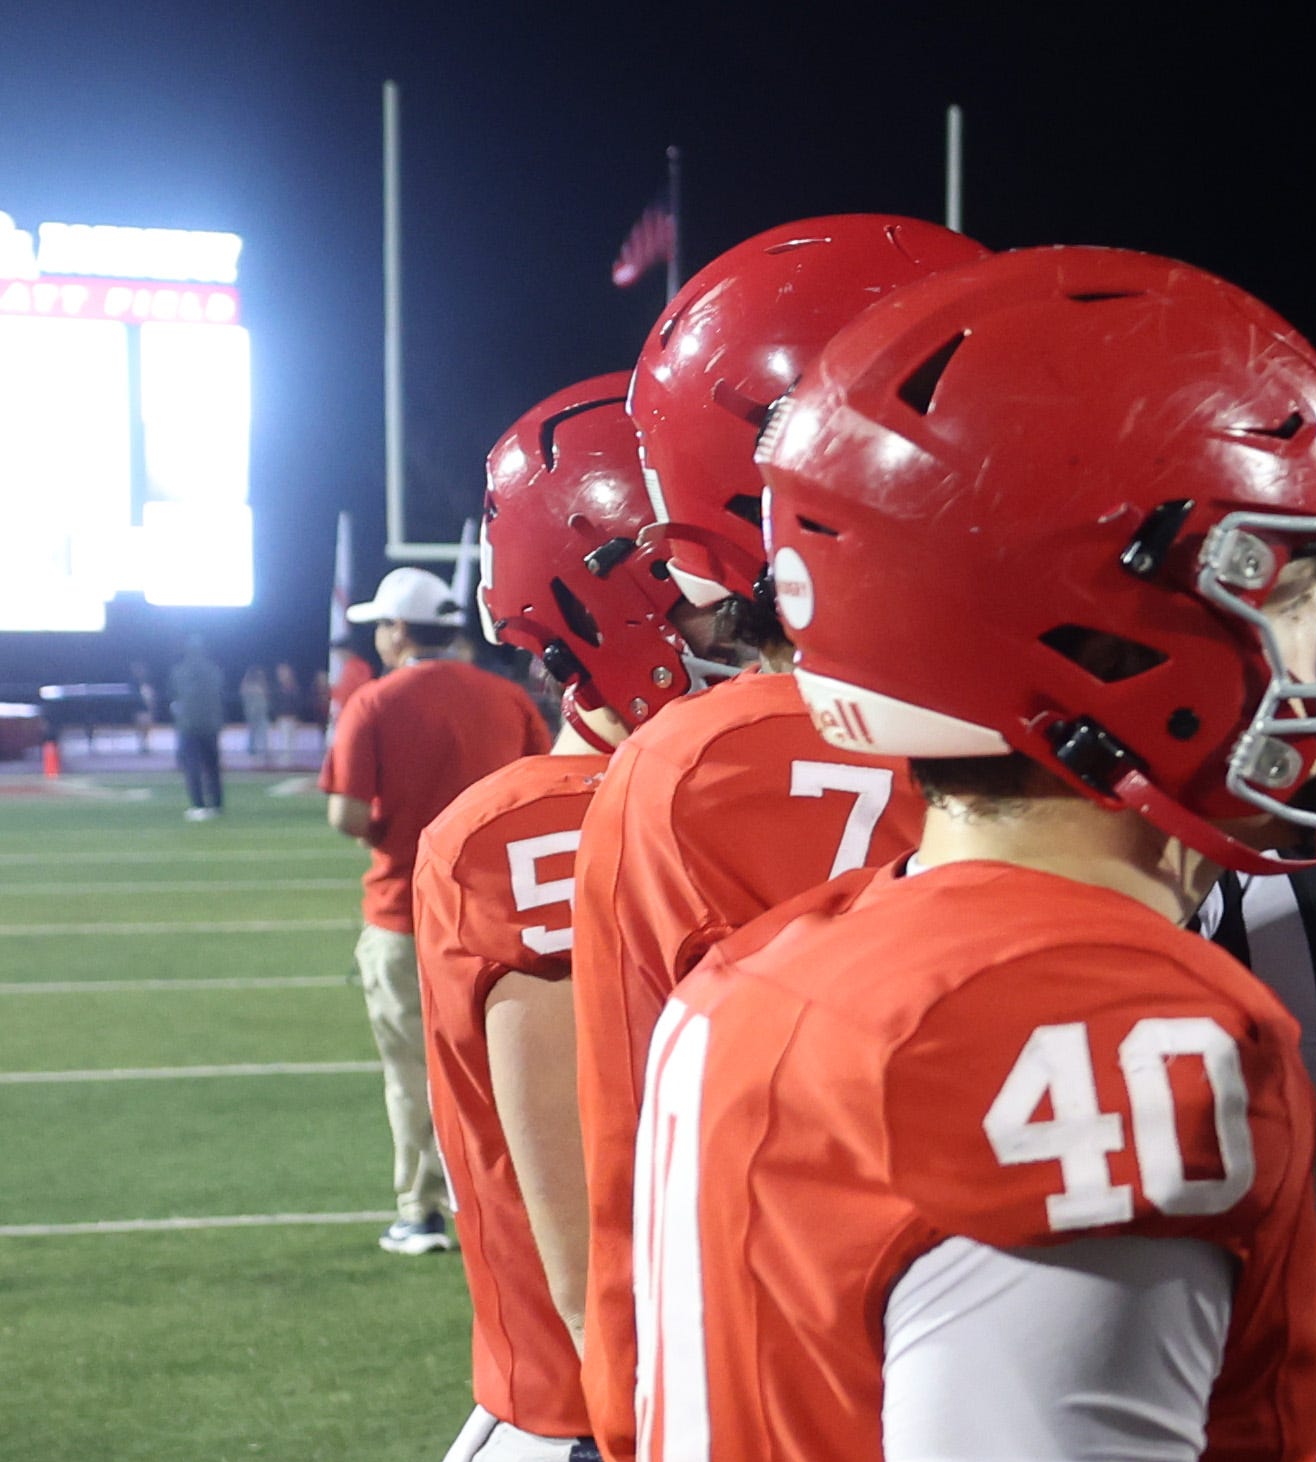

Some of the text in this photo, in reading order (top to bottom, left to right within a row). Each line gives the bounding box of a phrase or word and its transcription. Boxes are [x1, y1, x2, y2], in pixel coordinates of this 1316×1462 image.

[789, 759, 894, 881] 7
[505, 829, 583, 956] 5
[982, 1016, 1257, 1231] 40
